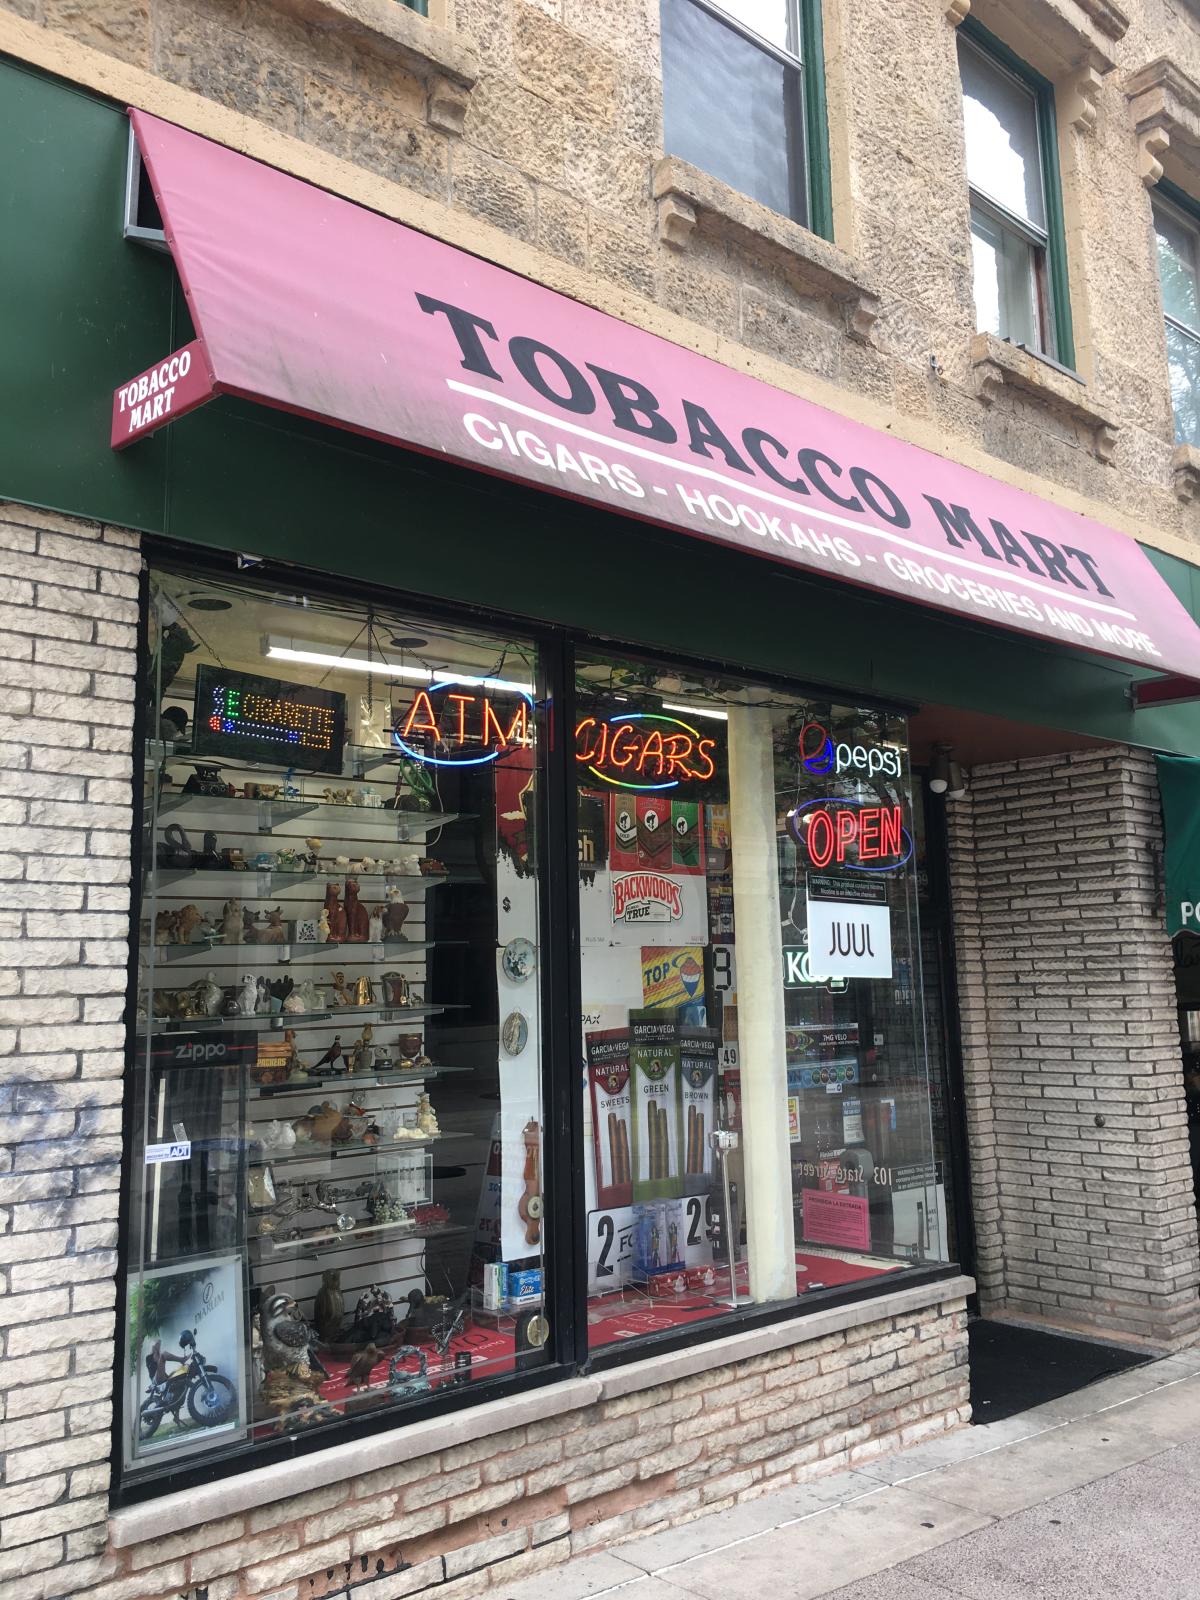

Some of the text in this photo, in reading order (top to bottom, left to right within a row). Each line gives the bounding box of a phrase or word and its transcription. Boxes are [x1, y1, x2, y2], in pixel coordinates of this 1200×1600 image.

[118, 351, 191, 413] TOBACCO
[128, 386, 175, 433] MART
[414, 292, 1115, 599] TOBACCO MART
[463, 412, 645, 498] CIGARS
[676, 484, 861, 567] HOOKAHS
[885, 551, 1044, 621] GROCERIES
[1047, 609, 1096, 638] AND
[1099, 621, 1162, 657] MORE
[403, 691, 527, 749] ATM
[576, 718, 716, 780] CIGARS
[835, 743, 901, 777] pepsi
[808, 806, 901, 868] OPEN
[614, 875, 680, 915] BACKWOODS
[626, 906, 650, 920] TRUE
[829, 922, 874, 957] JUUL
[644, 962, 671, 986] TOP
[634, 1025, 657, 1035] GARCIA
[175, 1042, 227, 1061] zippo
[591, 1044, 613, 1055] GARCIA
[637, 1049, 674, 1058] NATURAL
[257, 1057, 287, 1068] PACKERS
[595, 1064, 630, 1076] NATURAL
[681, 1060, 713, 1070] NATURAL
[643, 1084, 669, 1094] GREEN
[684, 1091, 709, 1100] BROWN
[600, 1096, 630, 1108] SWEETS
[171, 1146, 189, 1158] ADT
[596, 1215, 615, 1277] 2
